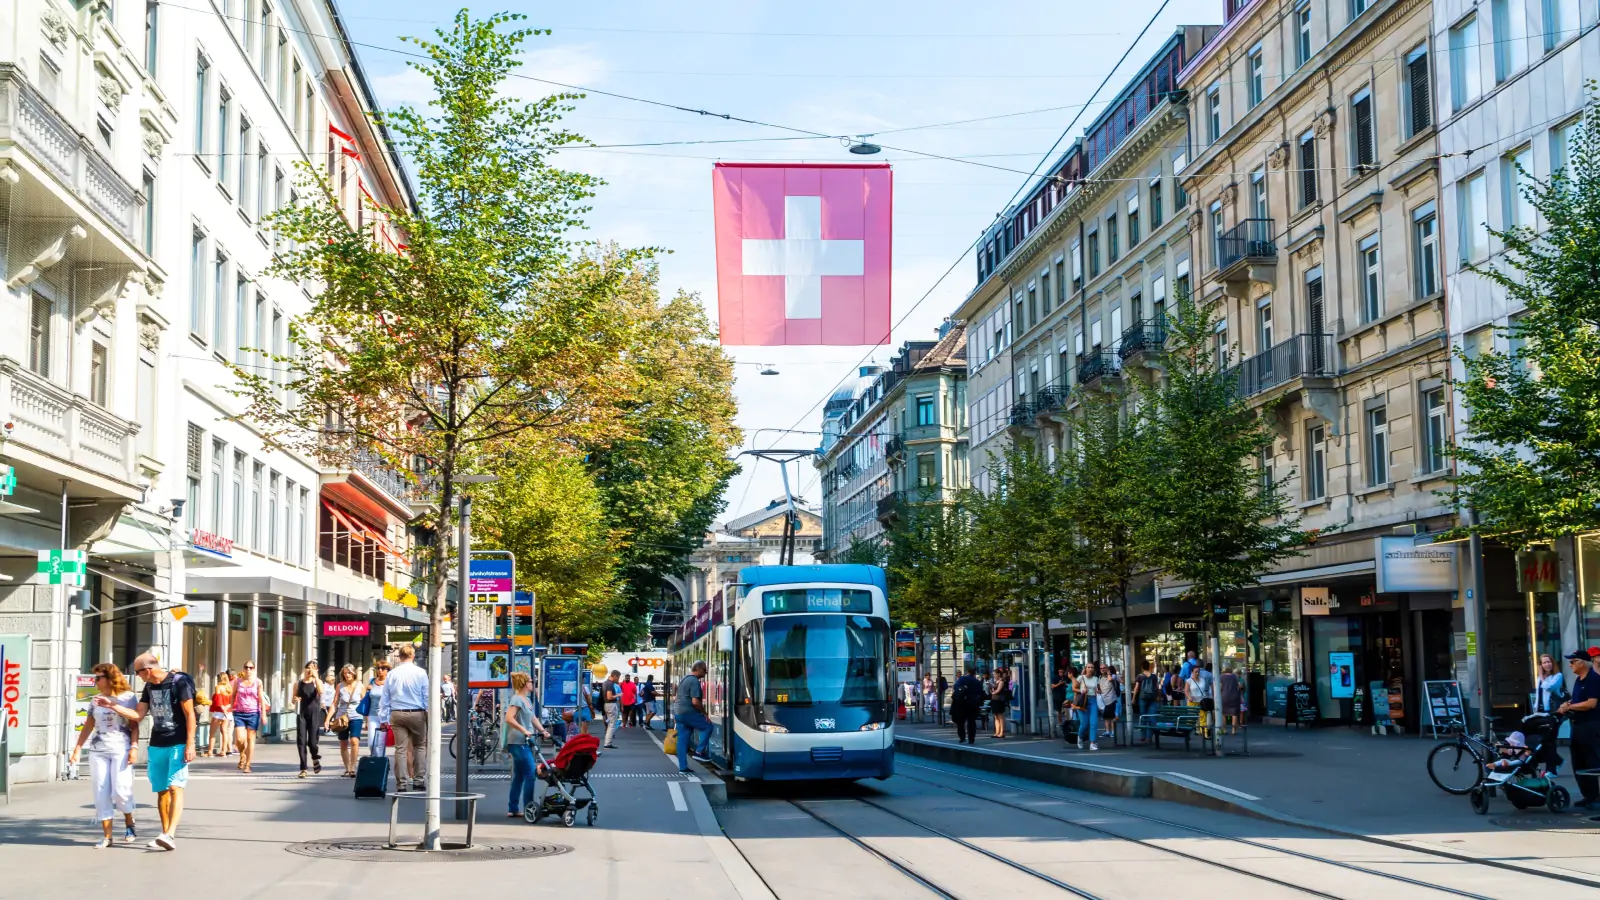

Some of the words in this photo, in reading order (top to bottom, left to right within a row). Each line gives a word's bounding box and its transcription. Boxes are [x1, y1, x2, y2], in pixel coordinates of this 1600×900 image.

[769, 596, 784, 608] 11
[807, 595, 851, 607] Rehalp
[1304, 596, 1327, 606] Salt.
[1328, 593, 1340, 608] alt.
[328, 624, 364, 632] BELDONA
[1174, 621, 1197, 629] GÖTTE
[628, 657, 665, 669] coop
[3, 658, 21, 729] SPORT
